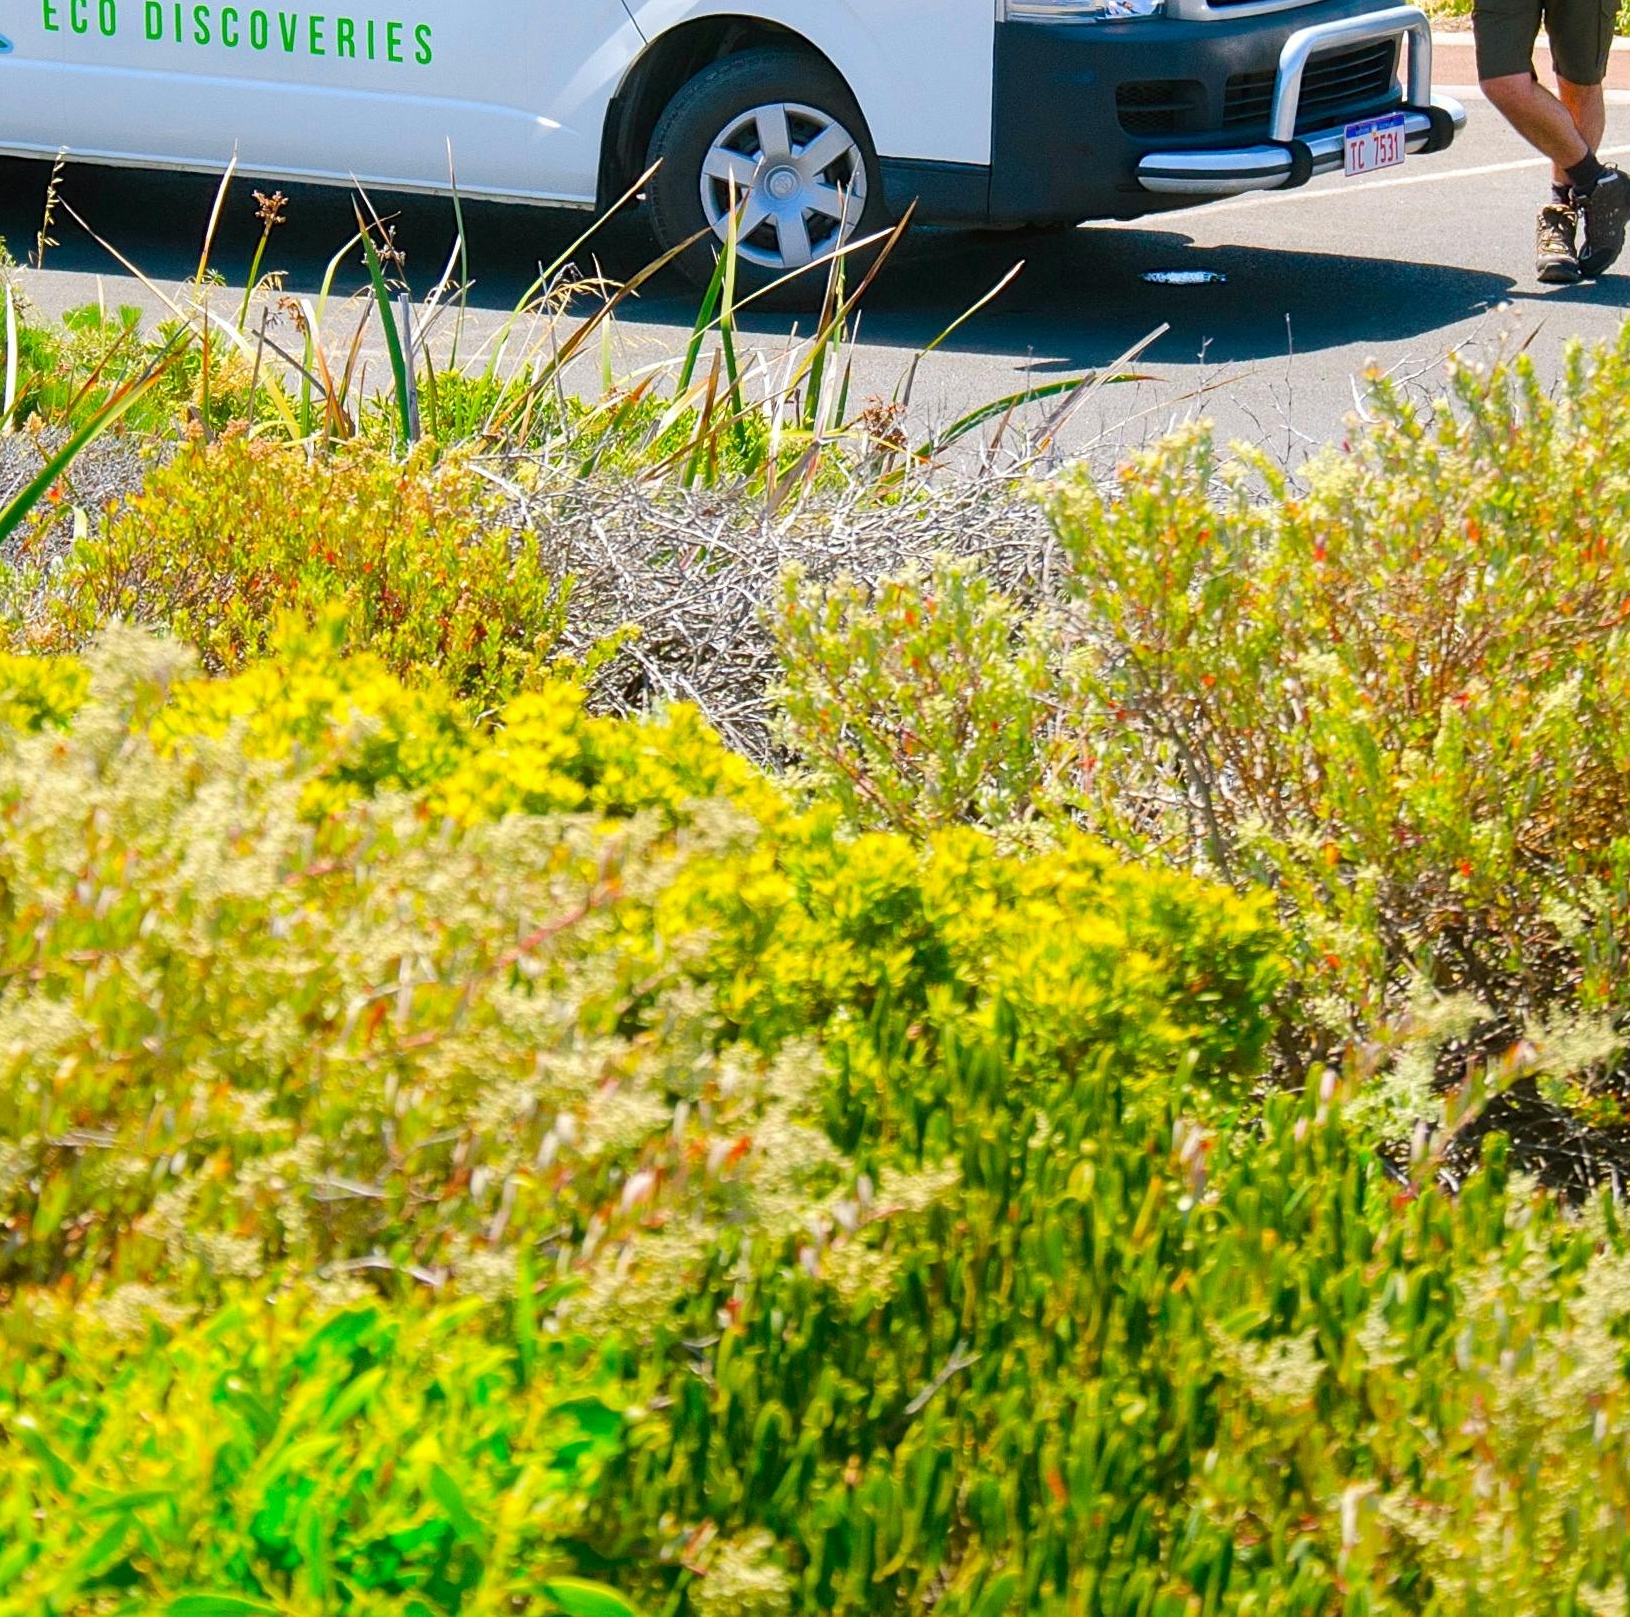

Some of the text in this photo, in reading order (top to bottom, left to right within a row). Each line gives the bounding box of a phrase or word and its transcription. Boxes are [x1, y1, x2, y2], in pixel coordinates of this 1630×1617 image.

[144, 0, 434, 65] DISCOVERIES
[1350, 131, 1399, 171] TC 7531
